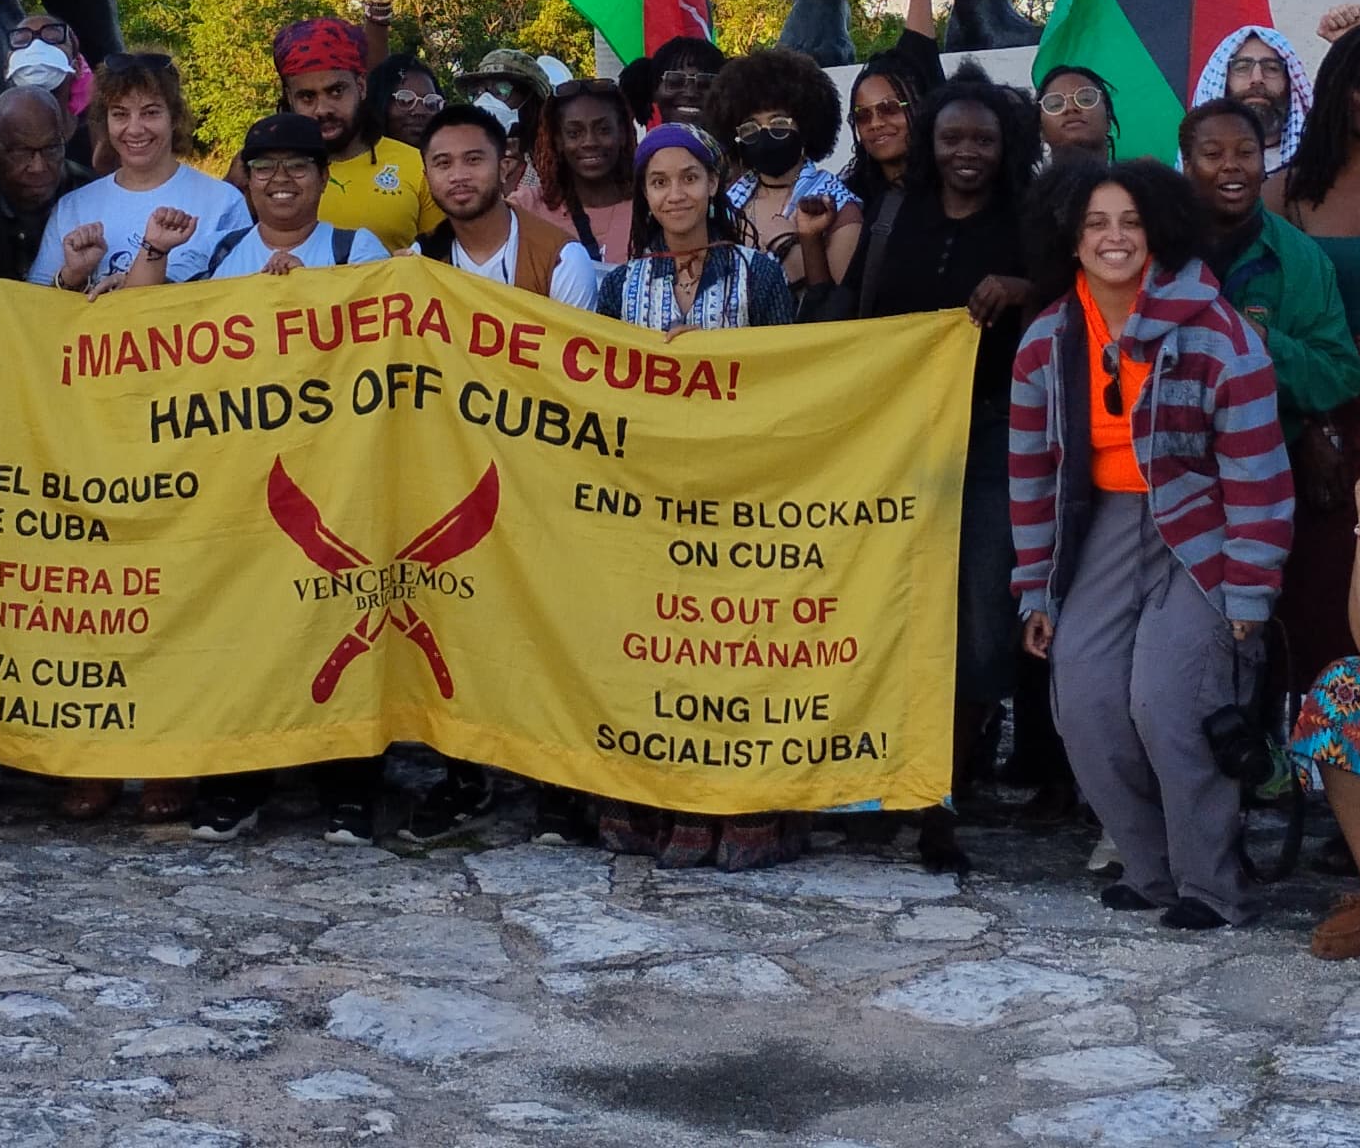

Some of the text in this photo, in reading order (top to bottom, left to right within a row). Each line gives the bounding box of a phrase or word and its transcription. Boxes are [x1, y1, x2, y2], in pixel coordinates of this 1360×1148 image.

[61, 292, 740, 401] ¡MANOS FUERA DE CUBA!
[150, 363, 627, 458] HANDS OFF CUBA!
[42, 471, 199, 504] BLOQUEO
[574, 482, 917, 529] END THE BLOCKADE
[15, 509, 110, 542] CUBA
[668, 539, 824, 569] ON CUBA
[123, 567, 161, 596] DE
[356, 585, 417, 611] BRIGDE
[656, 593, 838, 624] U.S. OUT OF
[623, 633, 858, 668] GUANTÁNAMO
[32, 658, 127, 688] CUBA
[654, 690, 829, 724] LONG LIVE
[596, 724, 888, 768] SOCIALIST CUBA!
